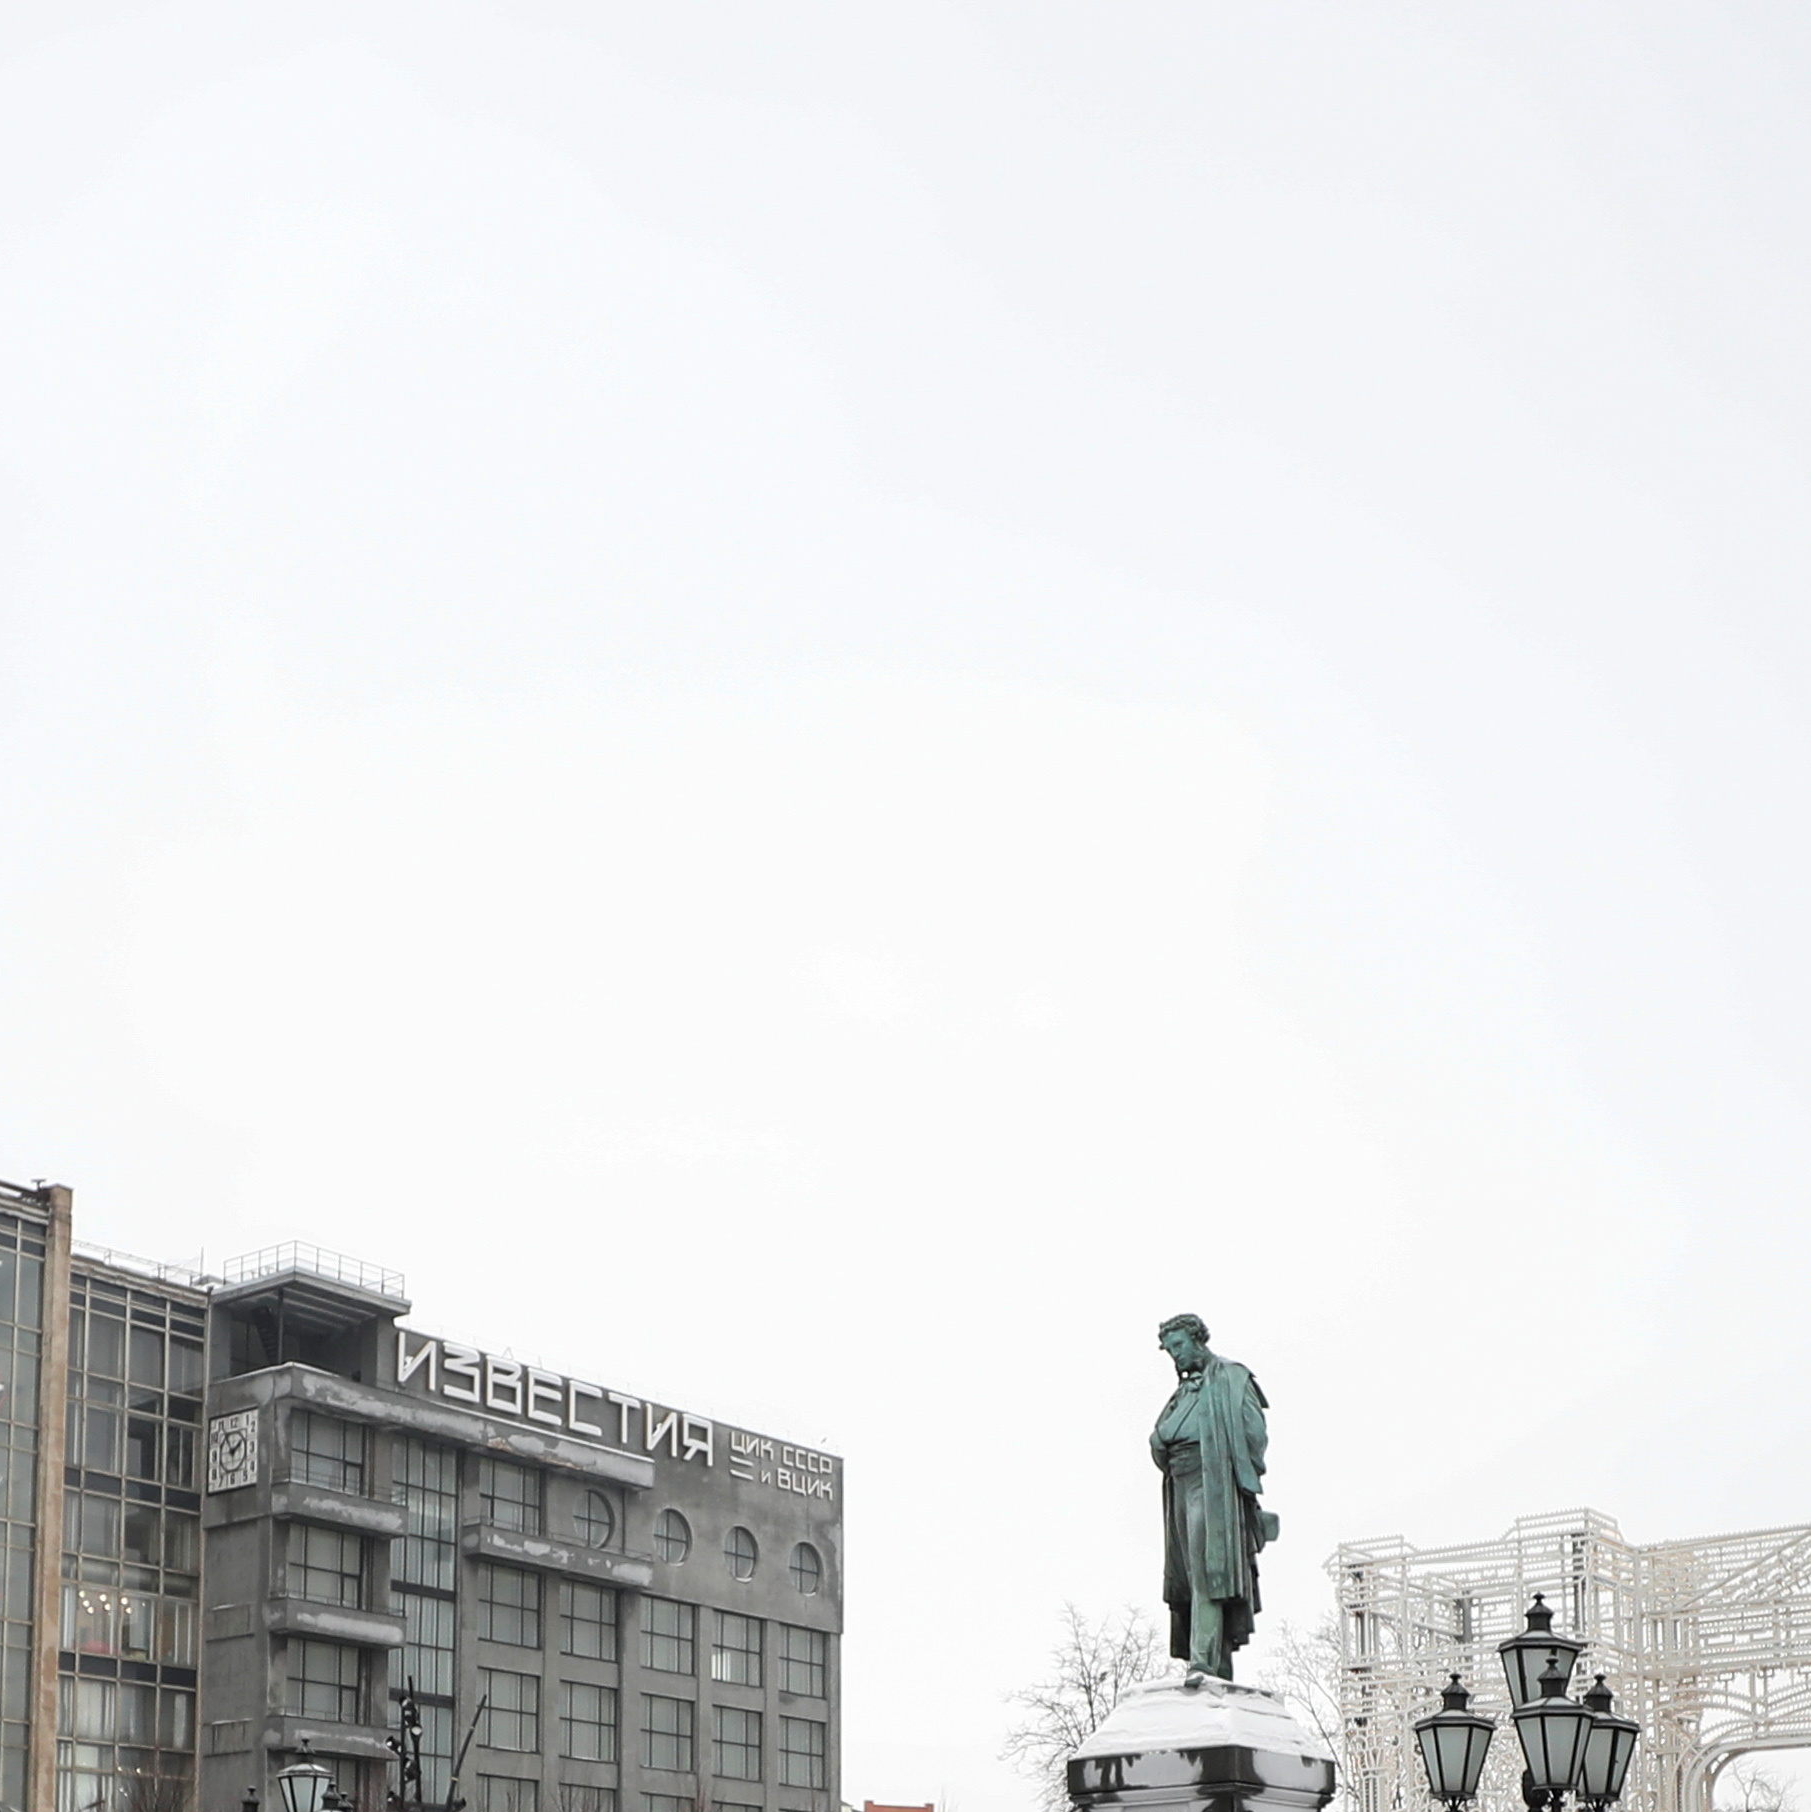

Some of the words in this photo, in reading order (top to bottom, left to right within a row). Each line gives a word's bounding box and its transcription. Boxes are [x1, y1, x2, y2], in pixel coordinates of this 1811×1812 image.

[396, 1331, 714, 1467] ИЗВЕСТИЯ
[730, 1430, 775, 1462] ЦИК
[781, 1444, 834, 1475] СССР
[776, 1467, 834, 1501] ВЦИК
